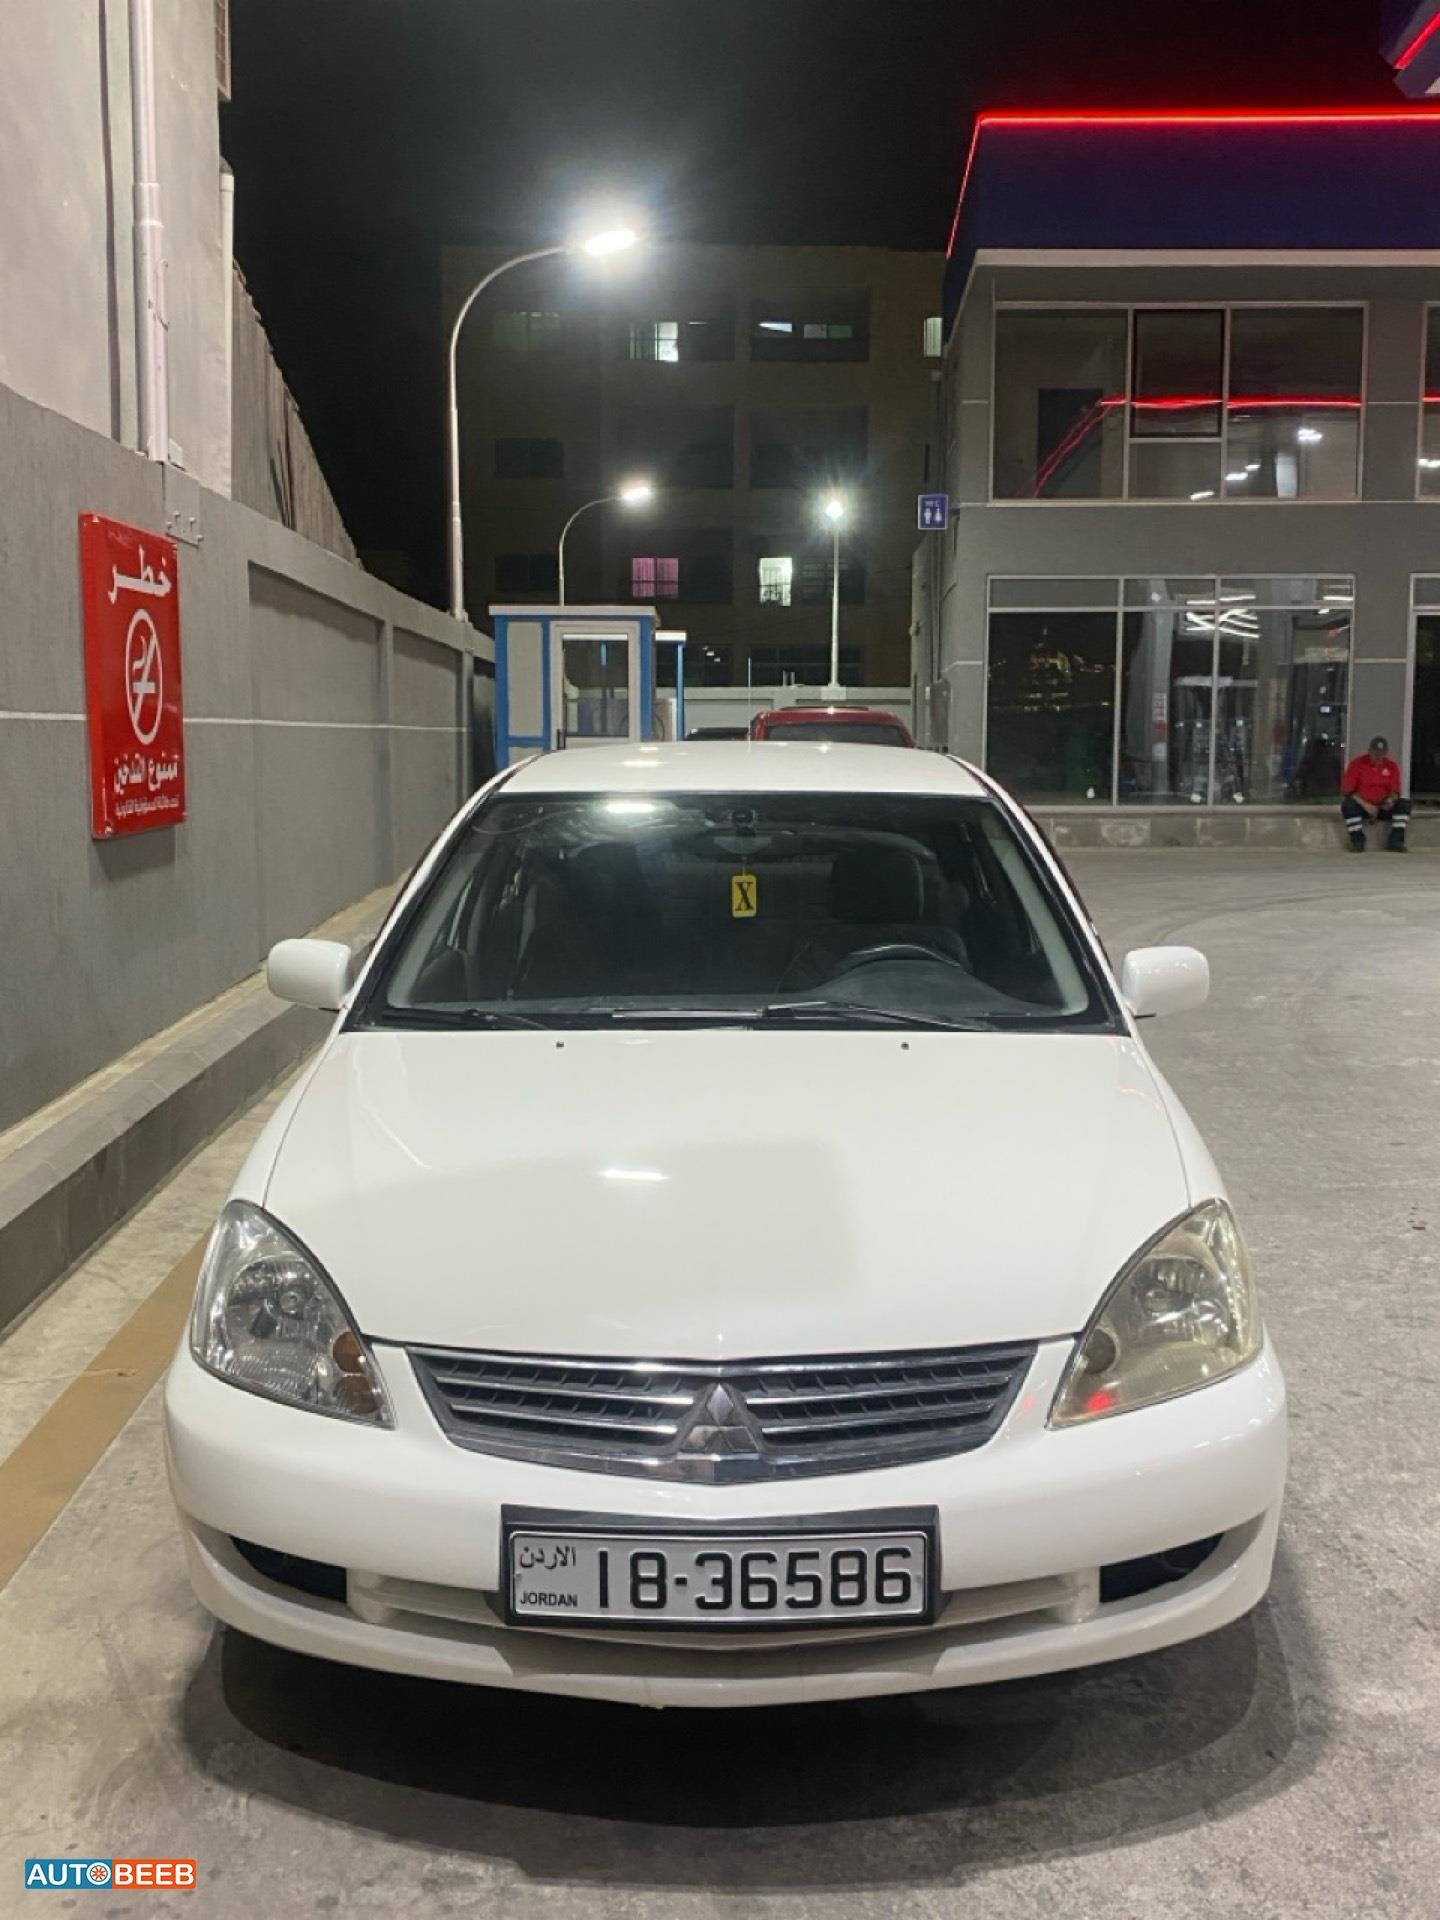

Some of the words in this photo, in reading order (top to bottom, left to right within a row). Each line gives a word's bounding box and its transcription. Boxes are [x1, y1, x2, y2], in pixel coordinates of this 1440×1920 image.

[109, 546, 171, 604] خطر
[113, 753, 146, 795] التدخين
[148, 751, 179, 792] ممنوع
[734, 881, 753, 911] X
[519, 1591, 579, 1608] JORDAN
